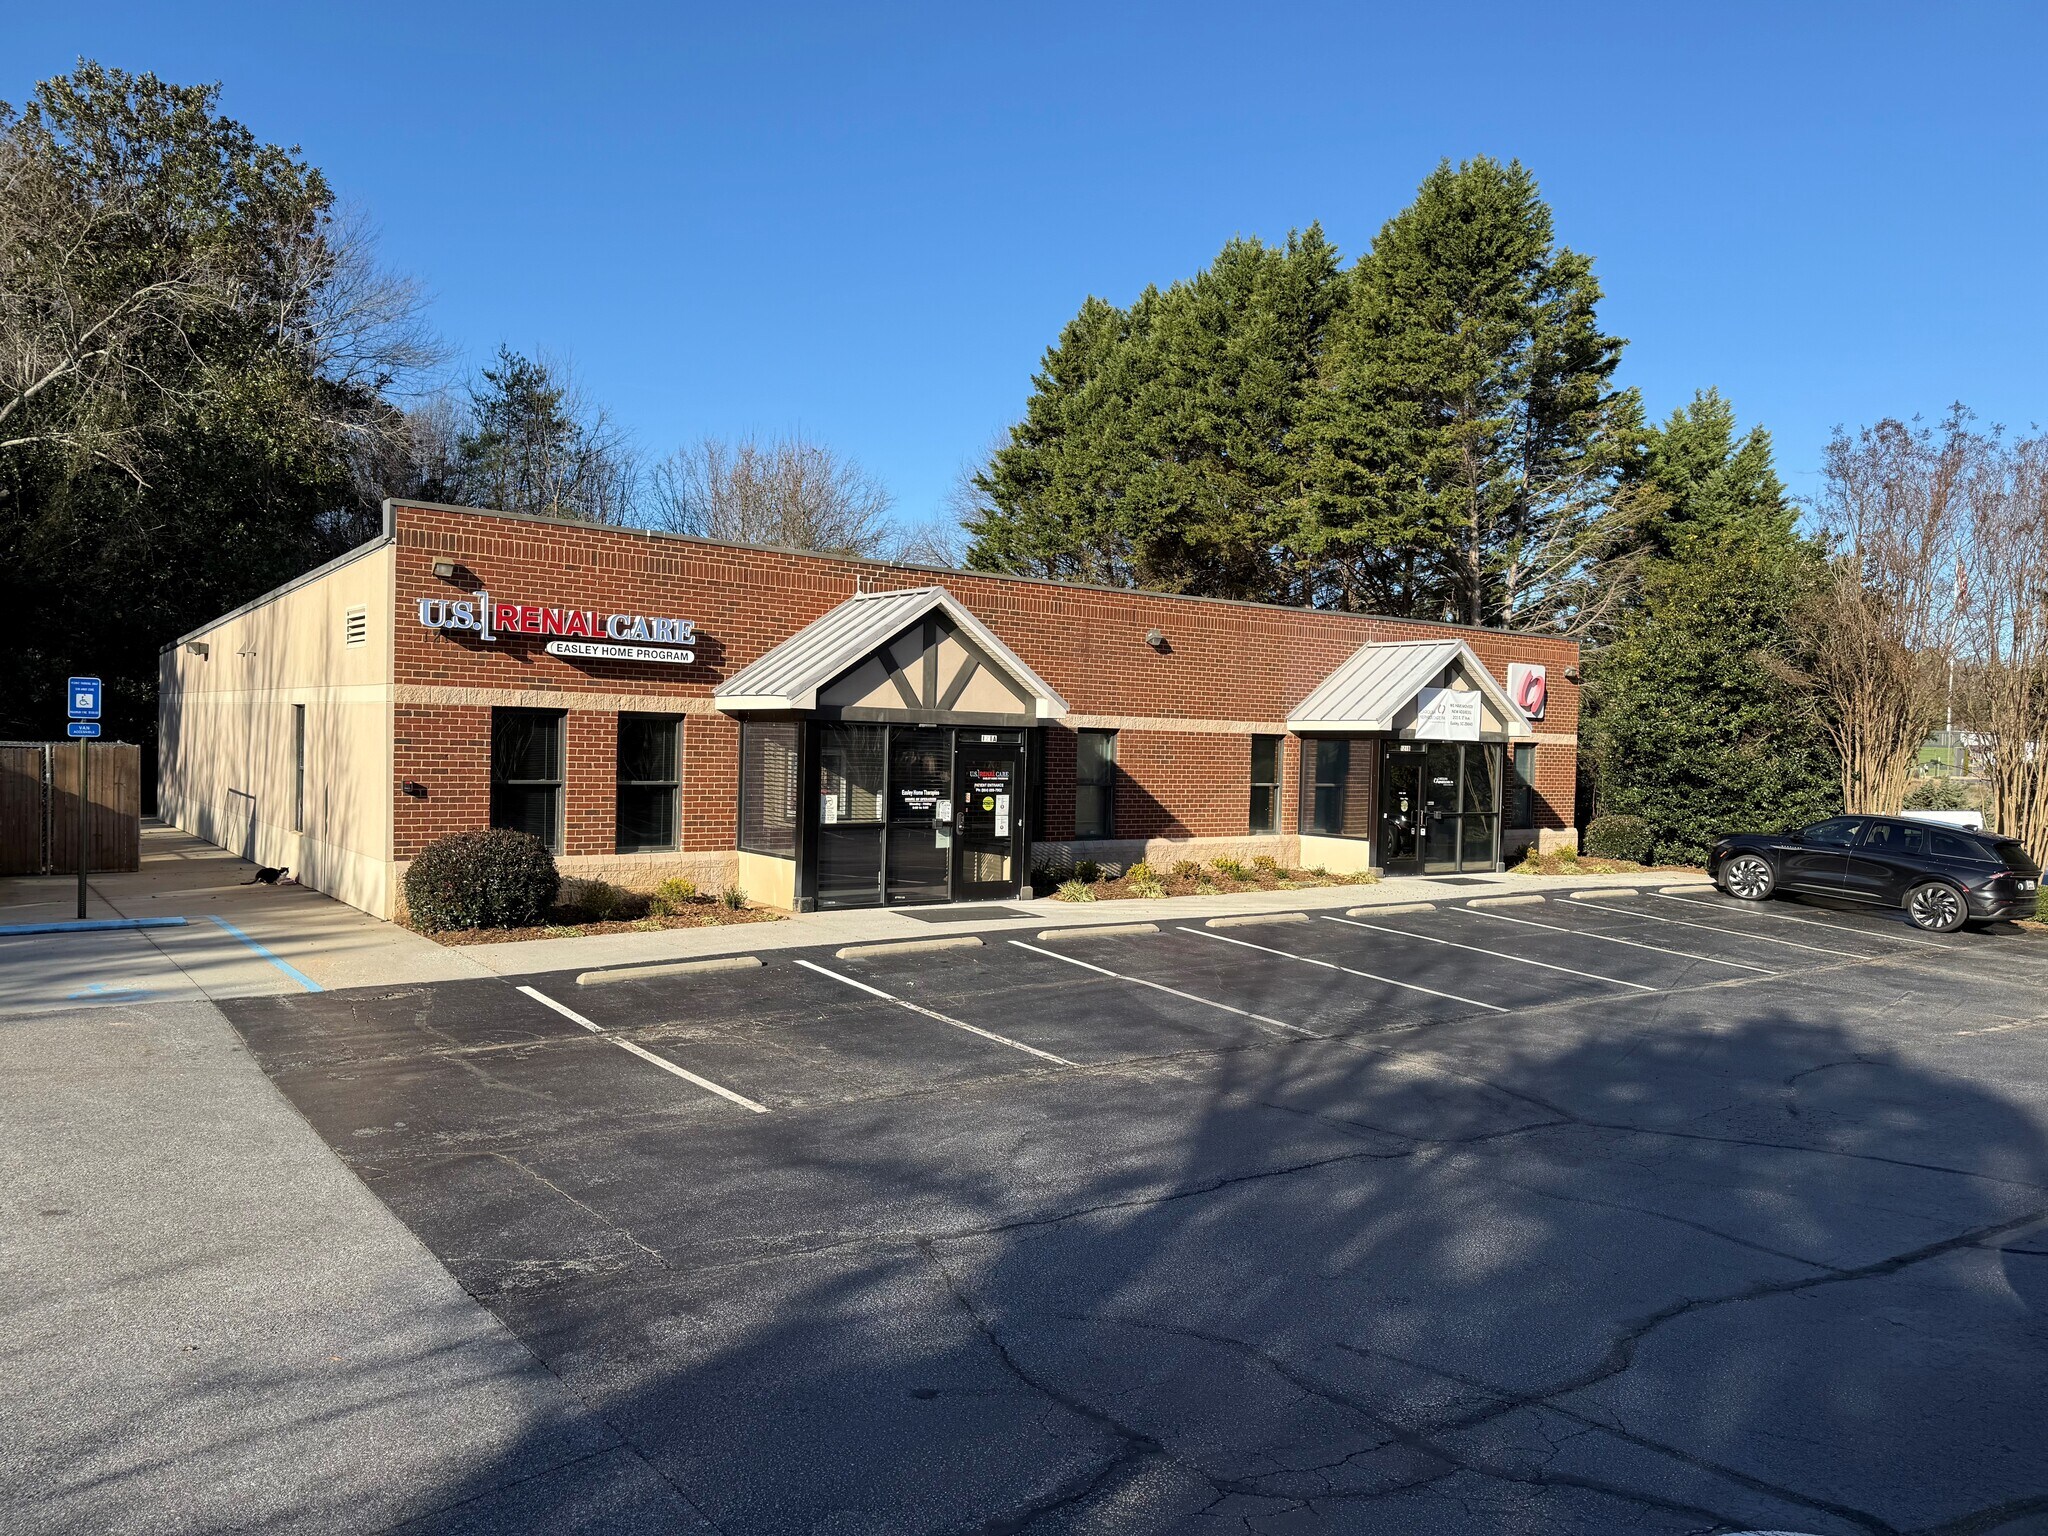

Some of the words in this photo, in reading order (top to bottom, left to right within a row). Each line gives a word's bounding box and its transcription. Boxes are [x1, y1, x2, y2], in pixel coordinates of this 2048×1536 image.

[416, 598, 481, 630] U.S.
[556, 643, 599, 655] EASLEY
[601, 645, 634, 658] HOME
[636, 648, 690, 662] PROGRAM
